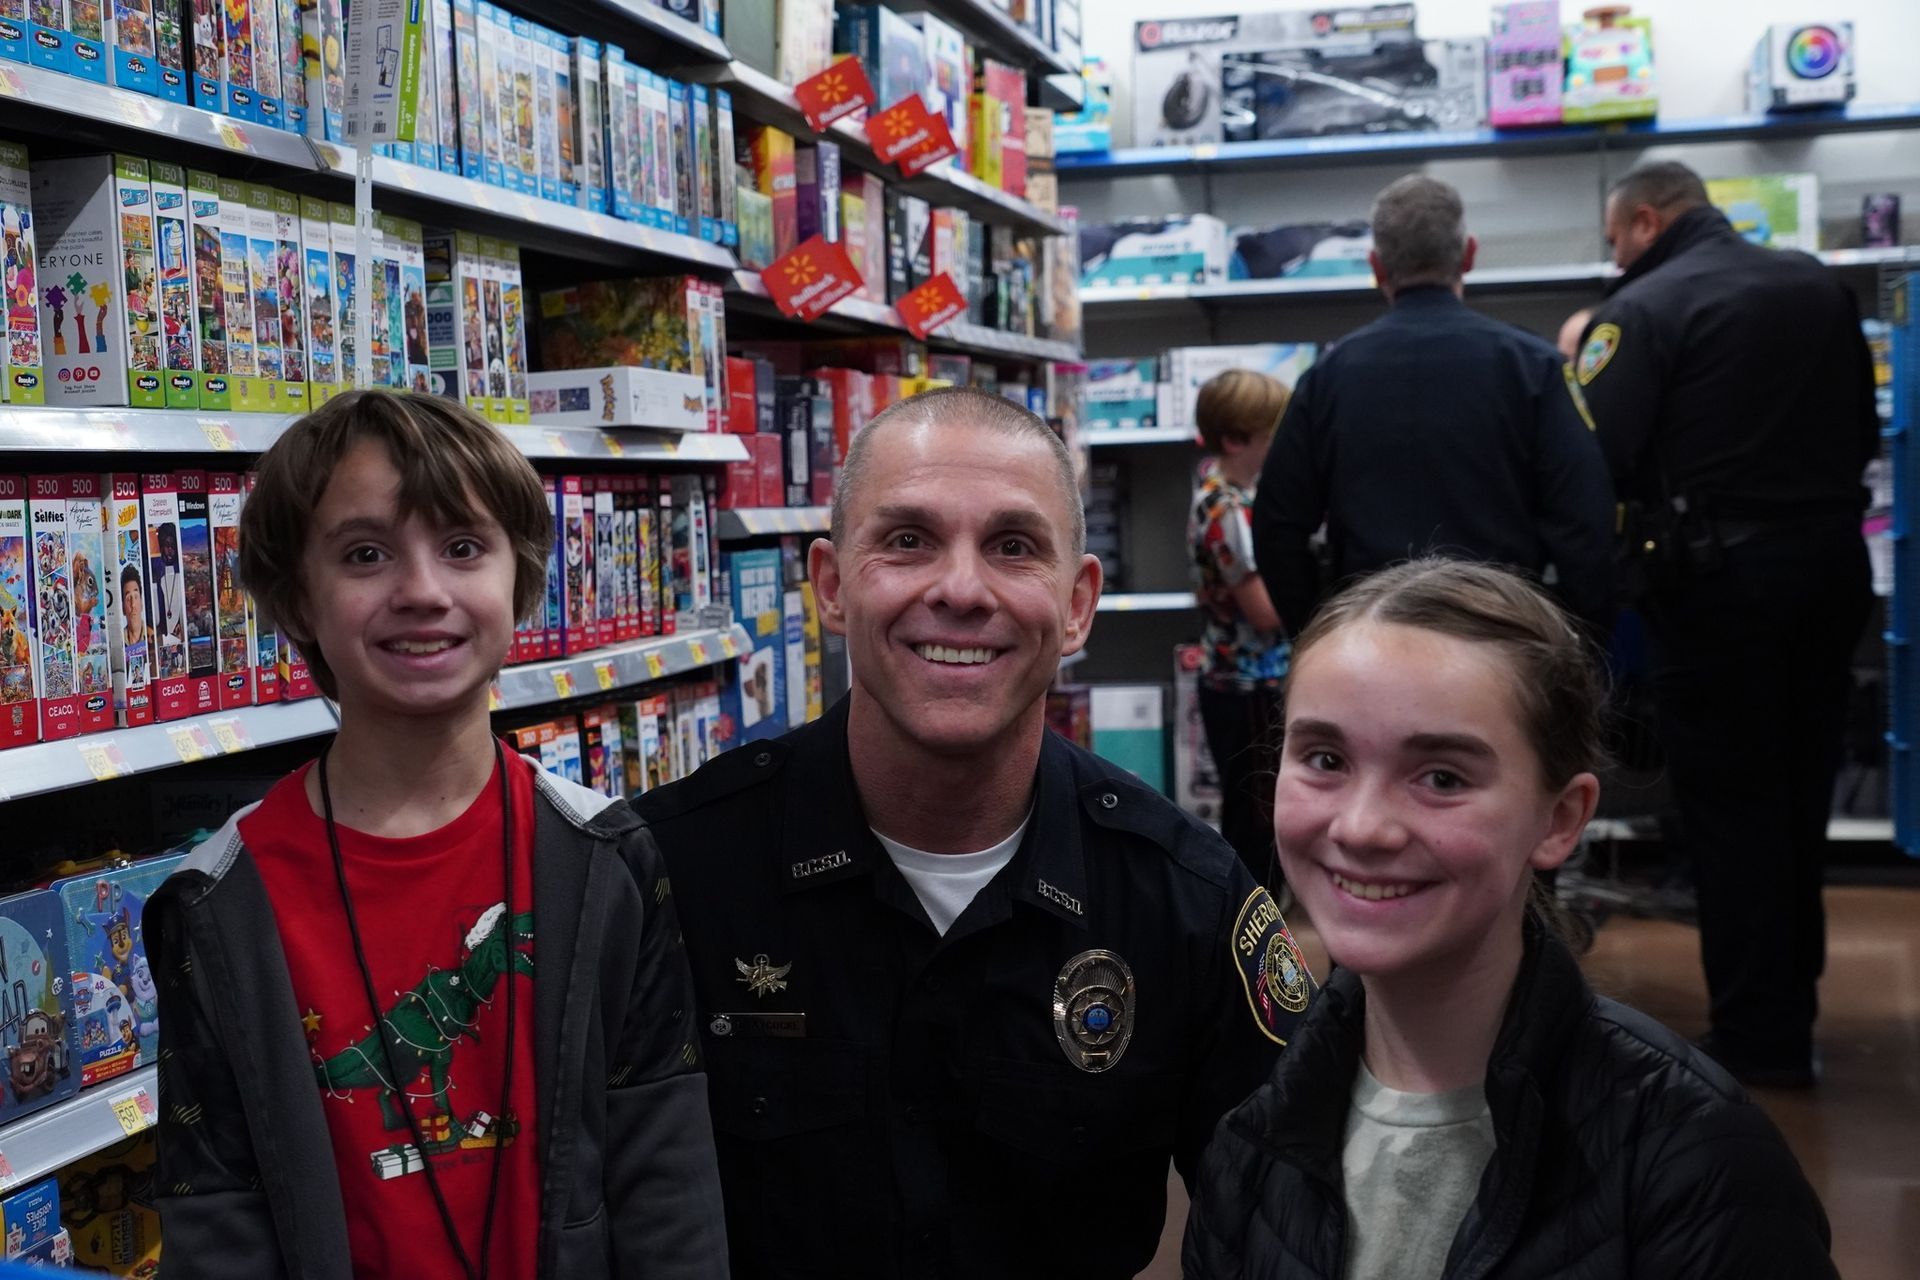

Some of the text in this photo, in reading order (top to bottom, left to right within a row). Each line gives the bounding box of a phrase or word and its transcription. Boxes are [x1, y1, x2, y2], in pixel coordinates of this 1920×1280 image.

[124, 162, 143, 177] 750
[159, 167, 177, 182] 750
[196, 175, 213, 190] 750
[222, 184, 240, 199] 750
[252, 192, 268, 207] 750
[275, 196, 292, 211] 750
[40, 252, 103, 269] ERYONE
[0, 480, 15, 495] 00
[37, 480, 59, 495] 500
[72, 479, 93, 494] 500
[116, 482, 136, 496] 500
[149, 474, 168, 490] 550
[182, 475, 200, 490] 500
[214, 477, 232, 491] 500
[186, 502, 206, 511] Windows
[35, 511, 65, 523] Selfies
[95, 981, 105, 991] 48
[99, 1045, 122, 1059] PUZZLE
[26, 1200, 53, 1224] KRISPIES
[32, 1216, 47, 1233] RICE
